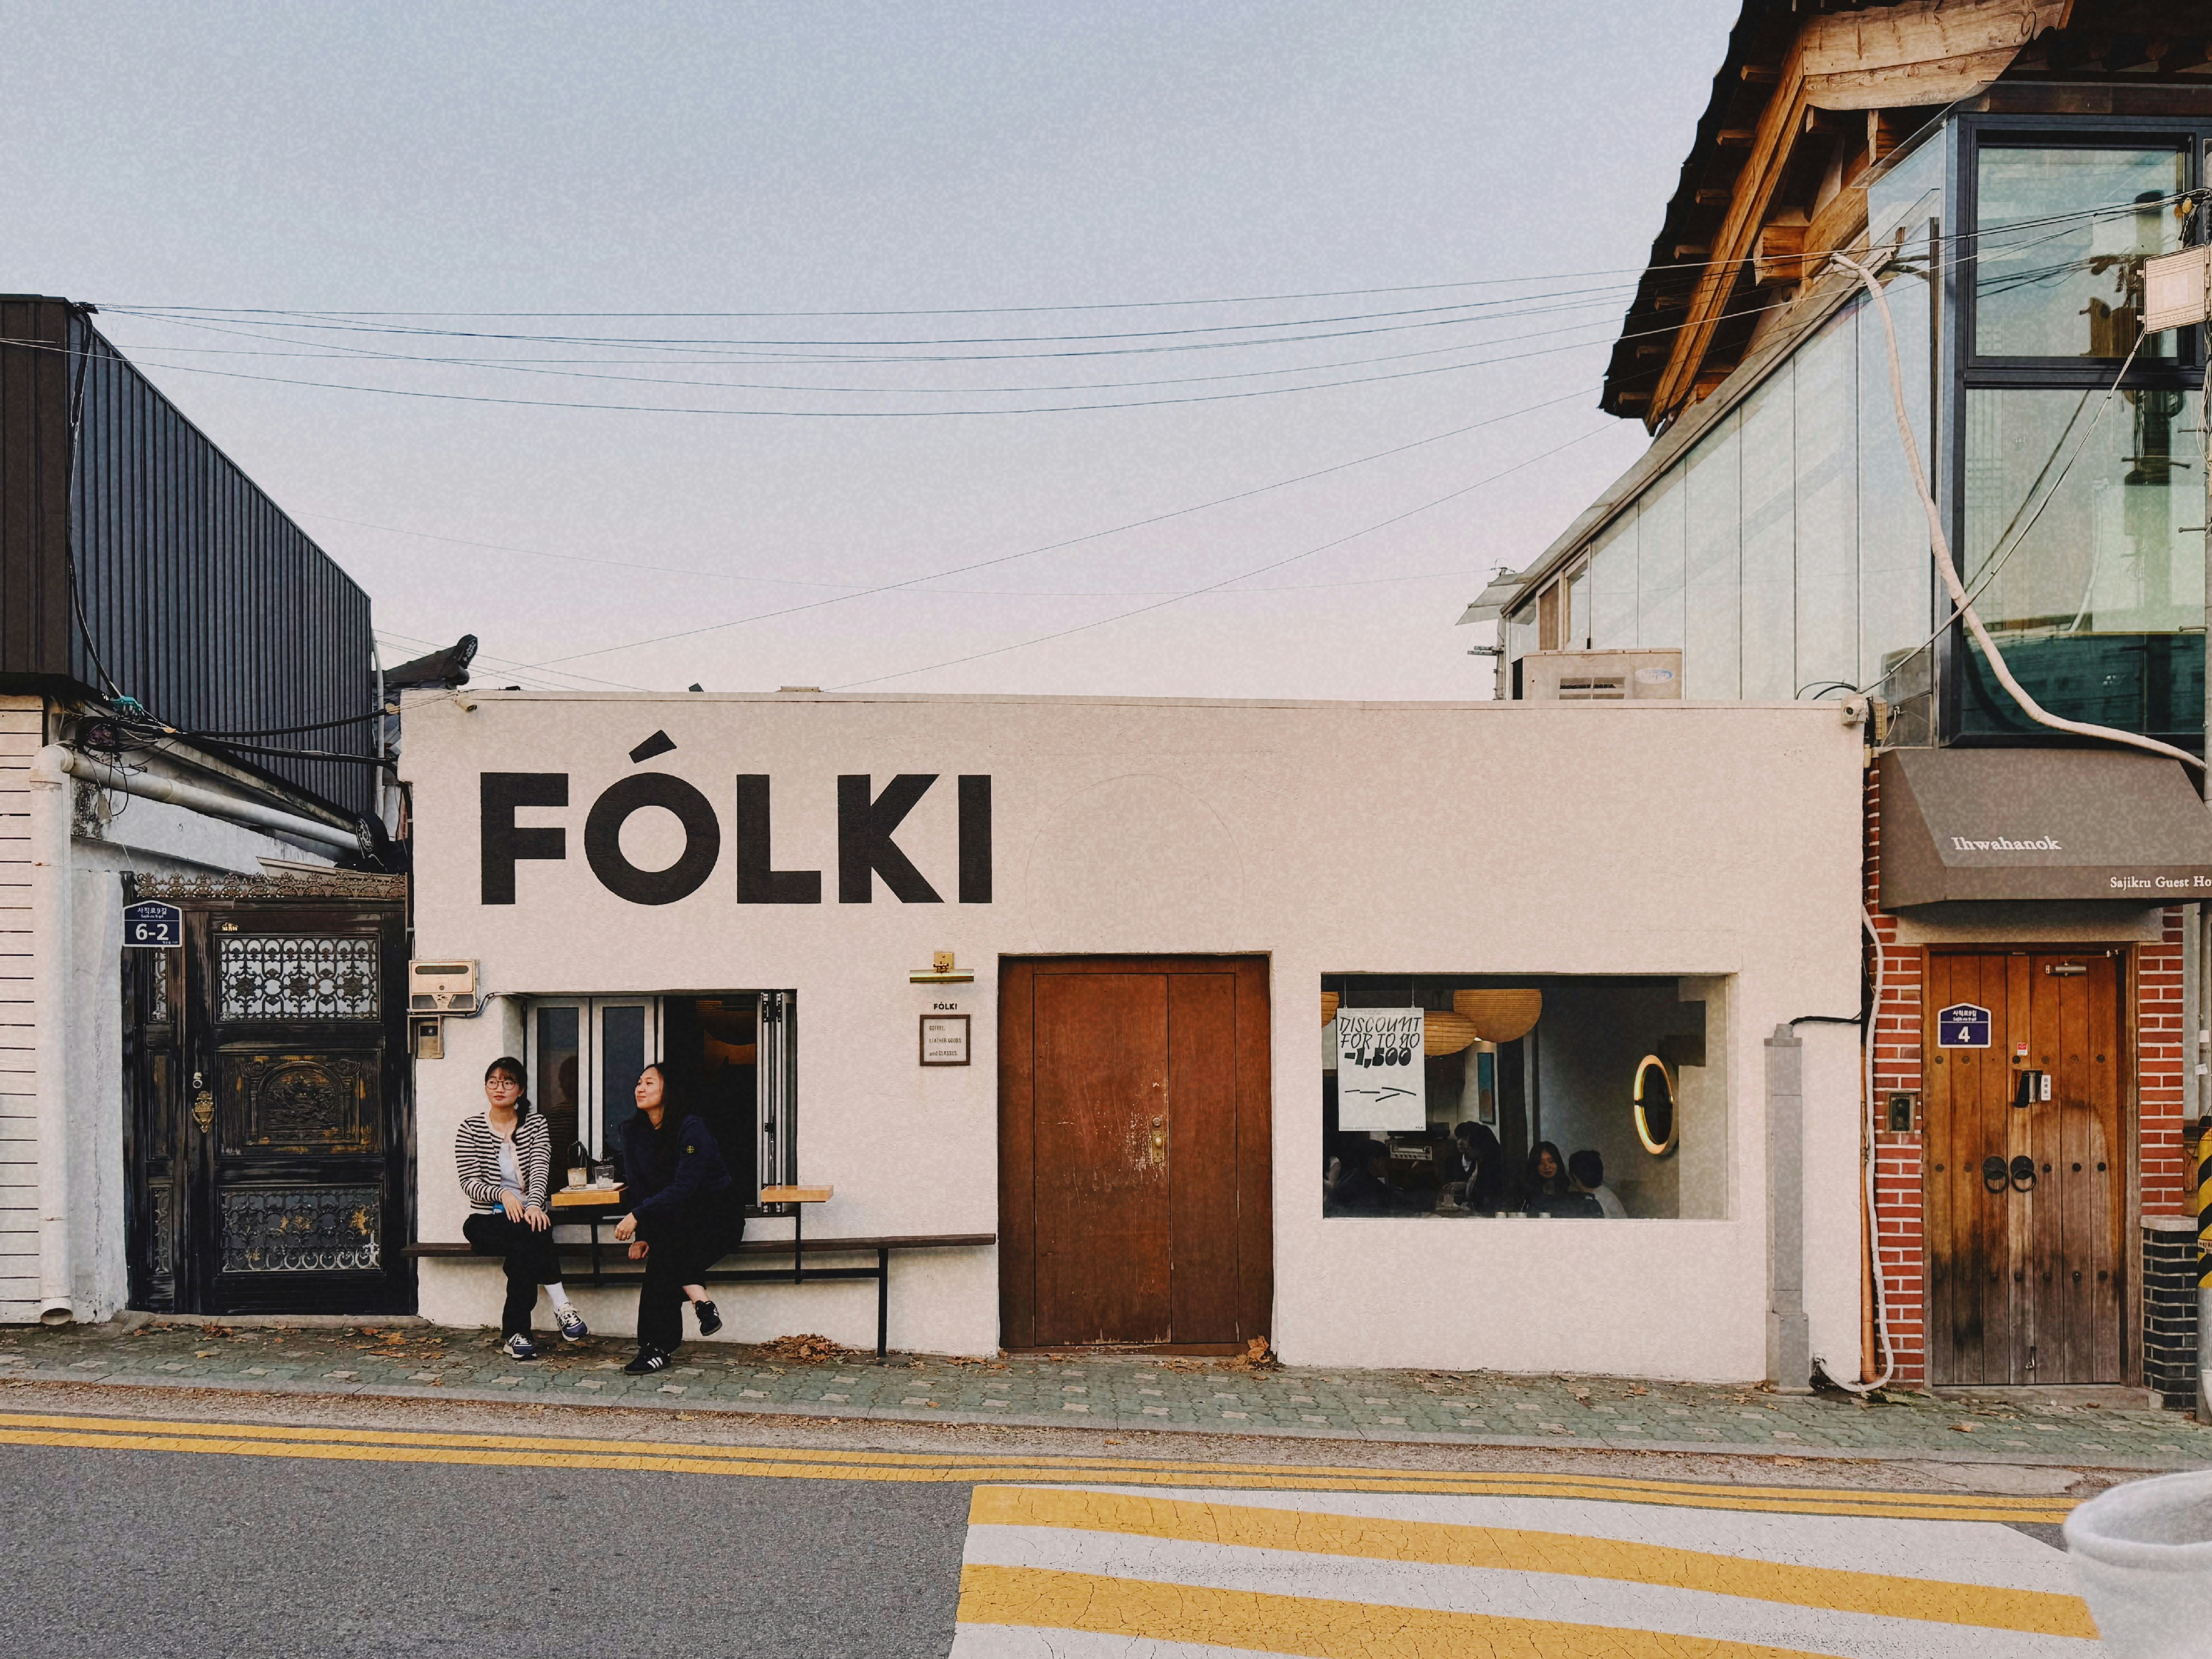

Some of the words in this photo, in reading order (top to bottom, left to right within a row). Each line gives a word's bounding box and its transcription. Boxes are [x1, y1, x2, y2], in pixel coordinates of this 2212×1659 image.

[480, 730, 992, 906] FÓLKI
[1950, 836, 2062, 851] Ihwahanok
[2155, 876, 2189, 888] Guest
[2193, 875, 2212, 887] Ho
[136, 924, 169, 940] 6-2
[934, 1001, 957, 1010] FÓLKI
[1340, 1017, 1422, 1034] DISCOUNT
[1341, 1033, 1373, 1049] FOR
[1377, 1033, 1396, 1048] TO
[1958, 1026, 1970, 1042] 4
